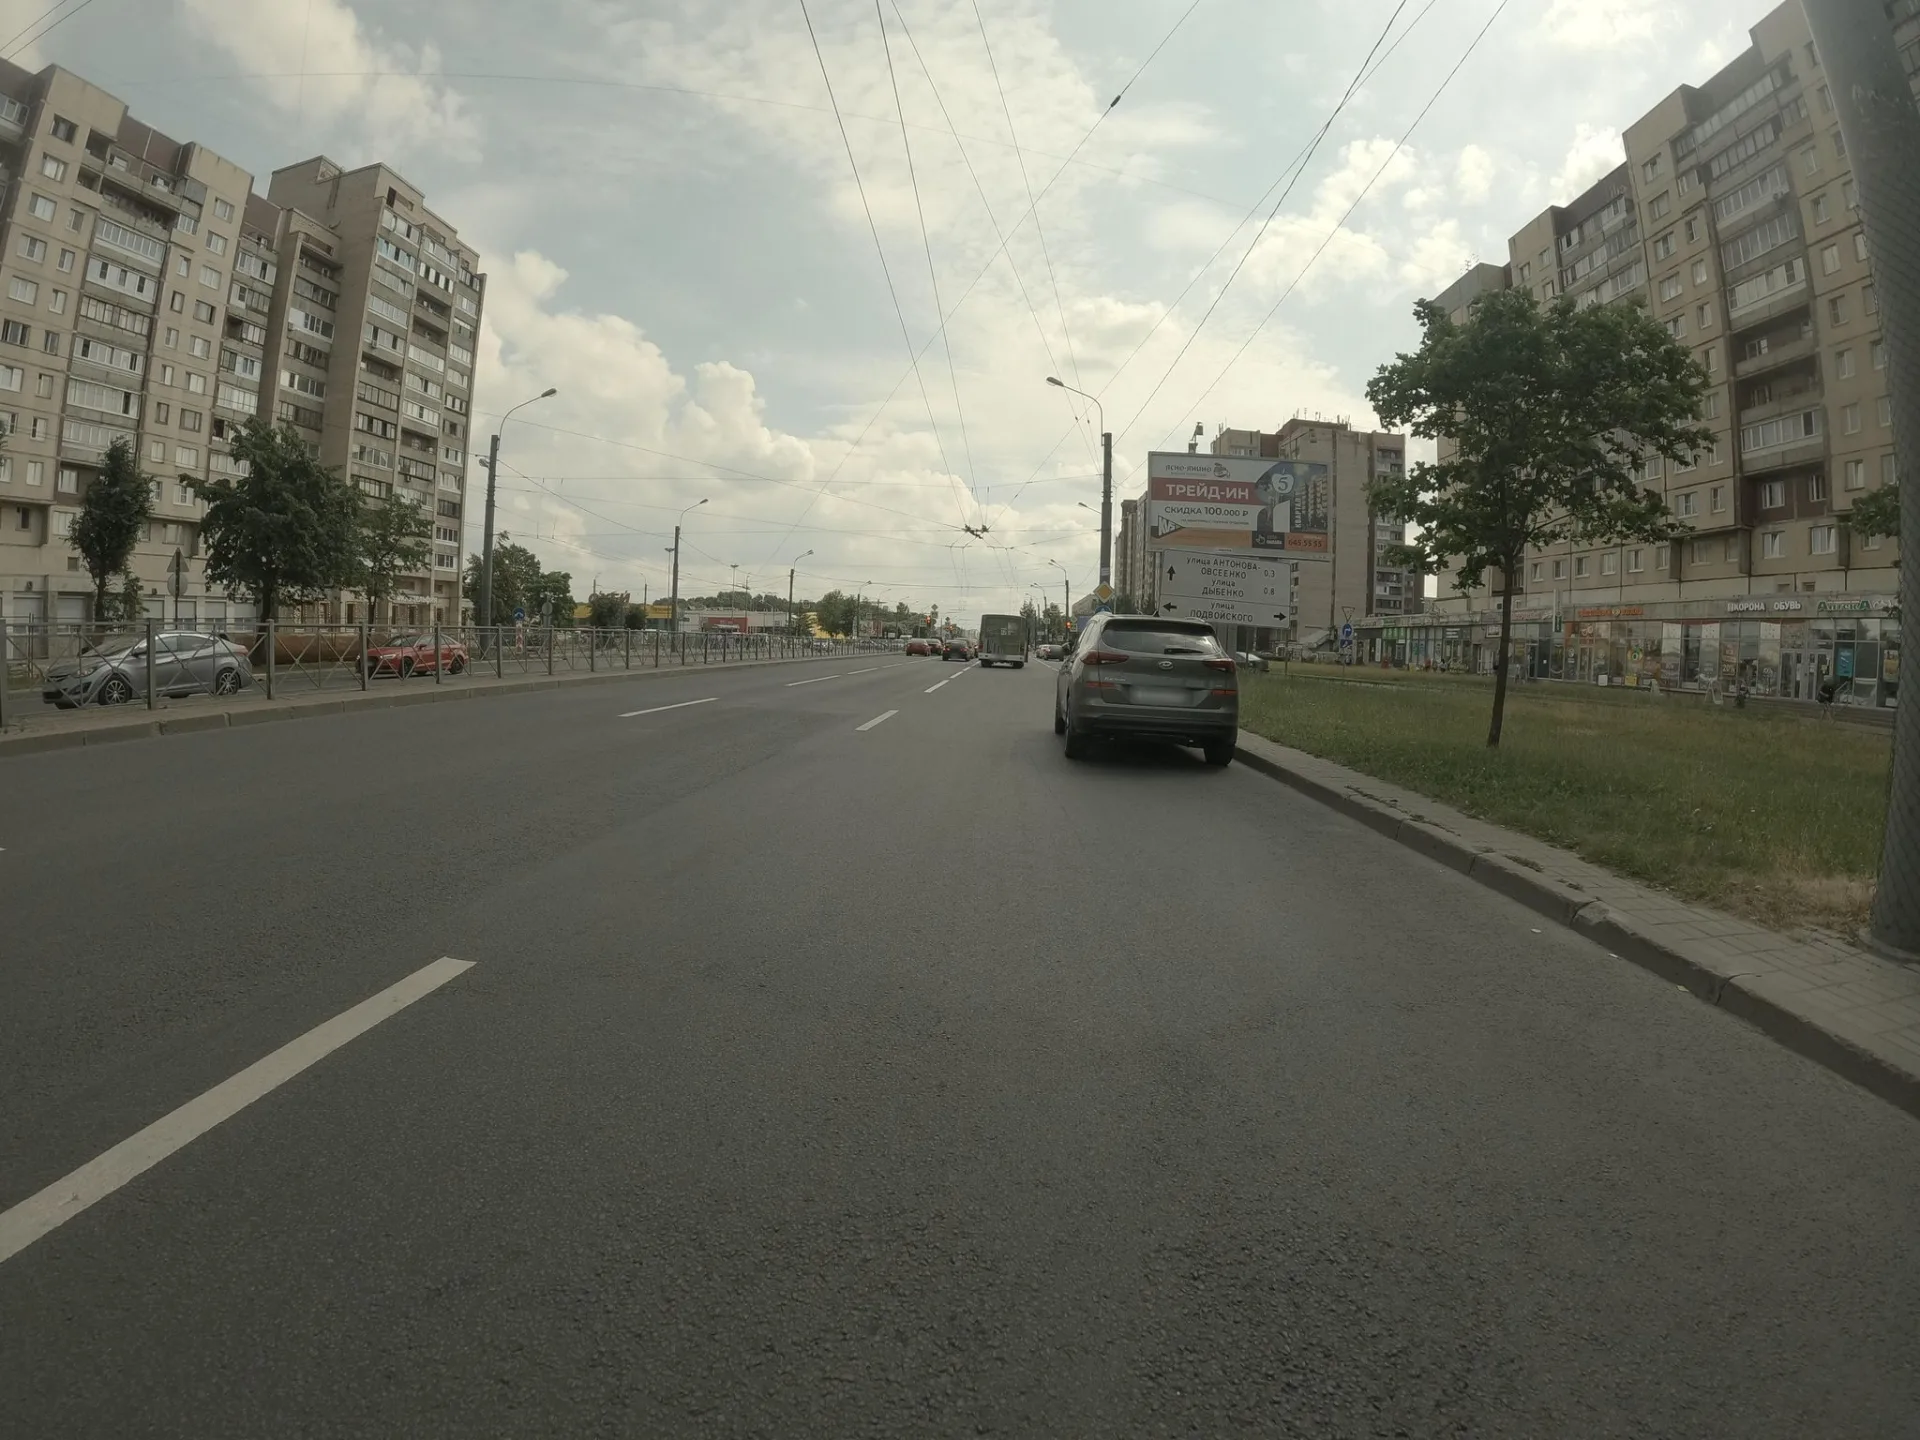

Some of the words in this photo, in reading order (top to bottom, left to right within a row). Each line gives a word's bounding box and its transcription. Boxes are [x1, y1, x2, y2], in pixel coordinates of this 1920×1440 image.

[1278, 476, 1288, 492] 5
[1165, 482, 1249, 500] ТРЕЙД-ИН
[1164, 506, 1202, 515] СКИДКА
[1186, 556, 1211, 565] улица
[1213, 557, 1261, 571] АНТОНОВА-
[1201, 568, 1247, 579] ОВСЕЕНКО
[1211, 578, 1236, 587] улица
[1201, 586, 1244, 598] ДЫБЕНКО
[1210, 601, 1235, 610] улица
[1773, 600, 1801, 611] ОБУВЬ
[1190, 609, 1254, 623] ПОДВОЙСКОГО
